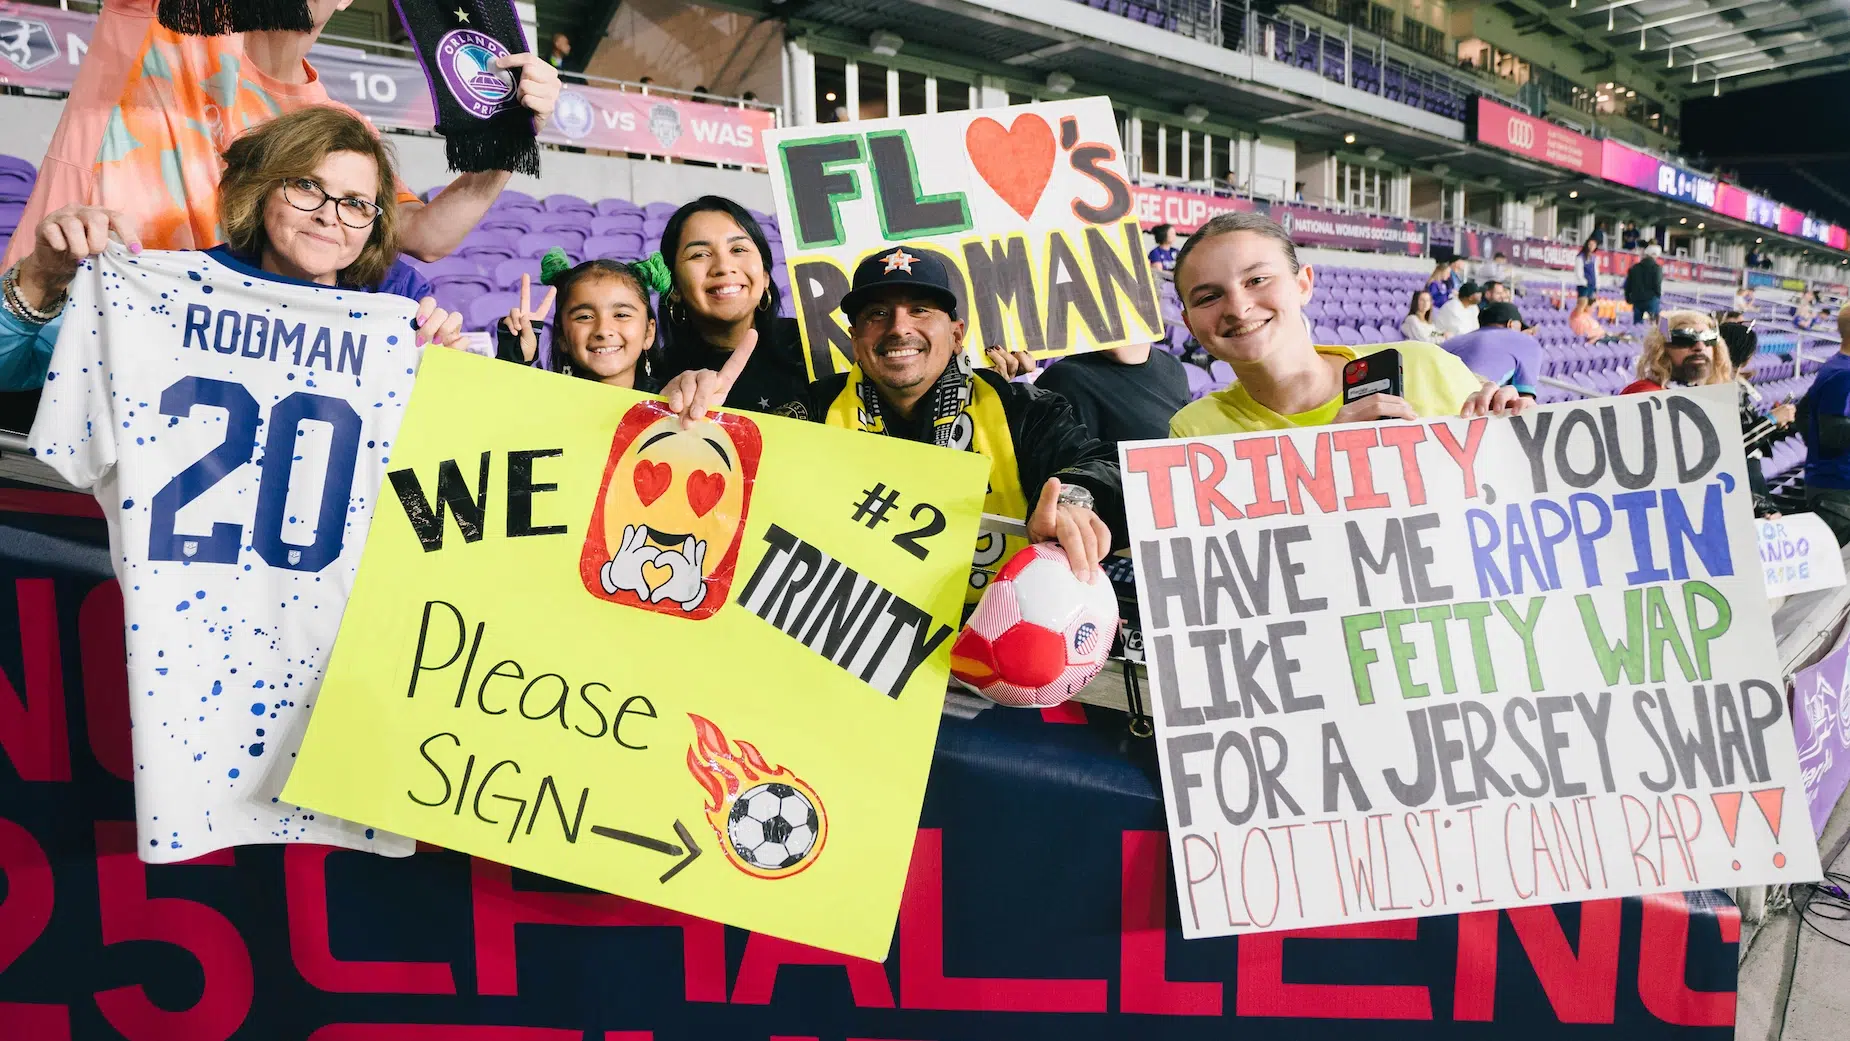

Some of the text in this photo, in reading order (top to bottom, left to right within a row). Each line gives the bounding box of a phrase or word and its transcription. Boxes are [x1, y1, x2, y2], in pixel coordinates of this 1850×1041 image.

[349, 70, 397, 103] 10
[601, 110, 754, 148] VS WAS
[778, 129, 974, 250] FL
[1165, 197, 1206, 226] CUP
[1294, 218, 1335, 235] NATIONAL
[1370, 227, 1398, 242] SOCCER
[1399, 230, 1424, 245] LEAGUE
[183, 303, 368, 377] RODMAN
[788, 217, 1164, 383] RMAN
[148, 375, 363, 573] 20
[387, 448, 568, 553] WE
[1125, 395, 1721, 530] TRINITY, YOU'D
[851, 482, 947, 562] #2
[1140, 472, 1735, 629] HAVE ME RAPPIN'
[736, 523, 954, 700] TRINITY
[1153, 581, 1733, 727] LIKE FETTY WAP
[407, 600, 658, 750] Please
[408, 732, 590, 843] SIGN
[1166, 726, 1305, 828] FOR
[1321, 721, 1373, 812] A
[1382, 692, 1616, 807] JERSEY
[1632, 679, 1783, 792] SWAP
[1181, 824, 1306, 930] PLOT
